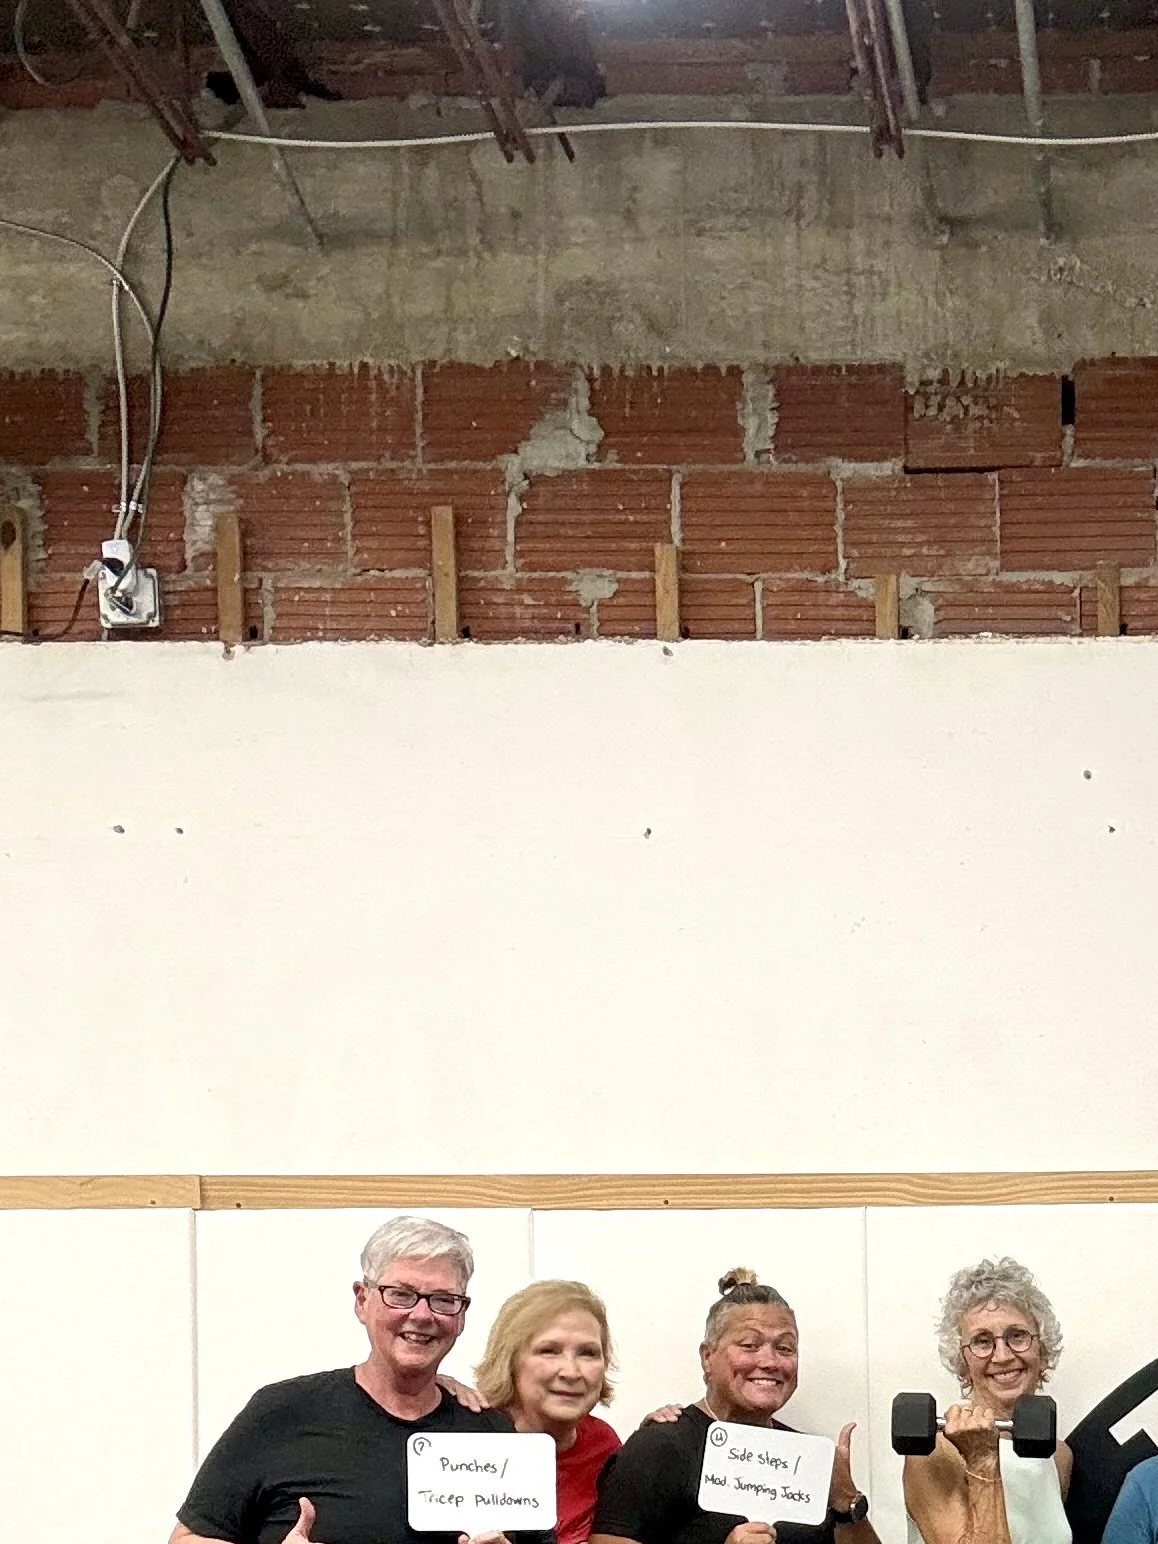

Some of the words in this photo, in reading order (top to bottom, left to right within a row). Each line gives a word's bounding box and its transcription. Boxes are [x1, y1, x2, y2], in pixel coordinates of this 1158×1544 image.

[728, 1447, 753, 1462] Side
[734, 1476, 777, 1501] Jumping
[781, 1486, 811, 1504] Jacks
